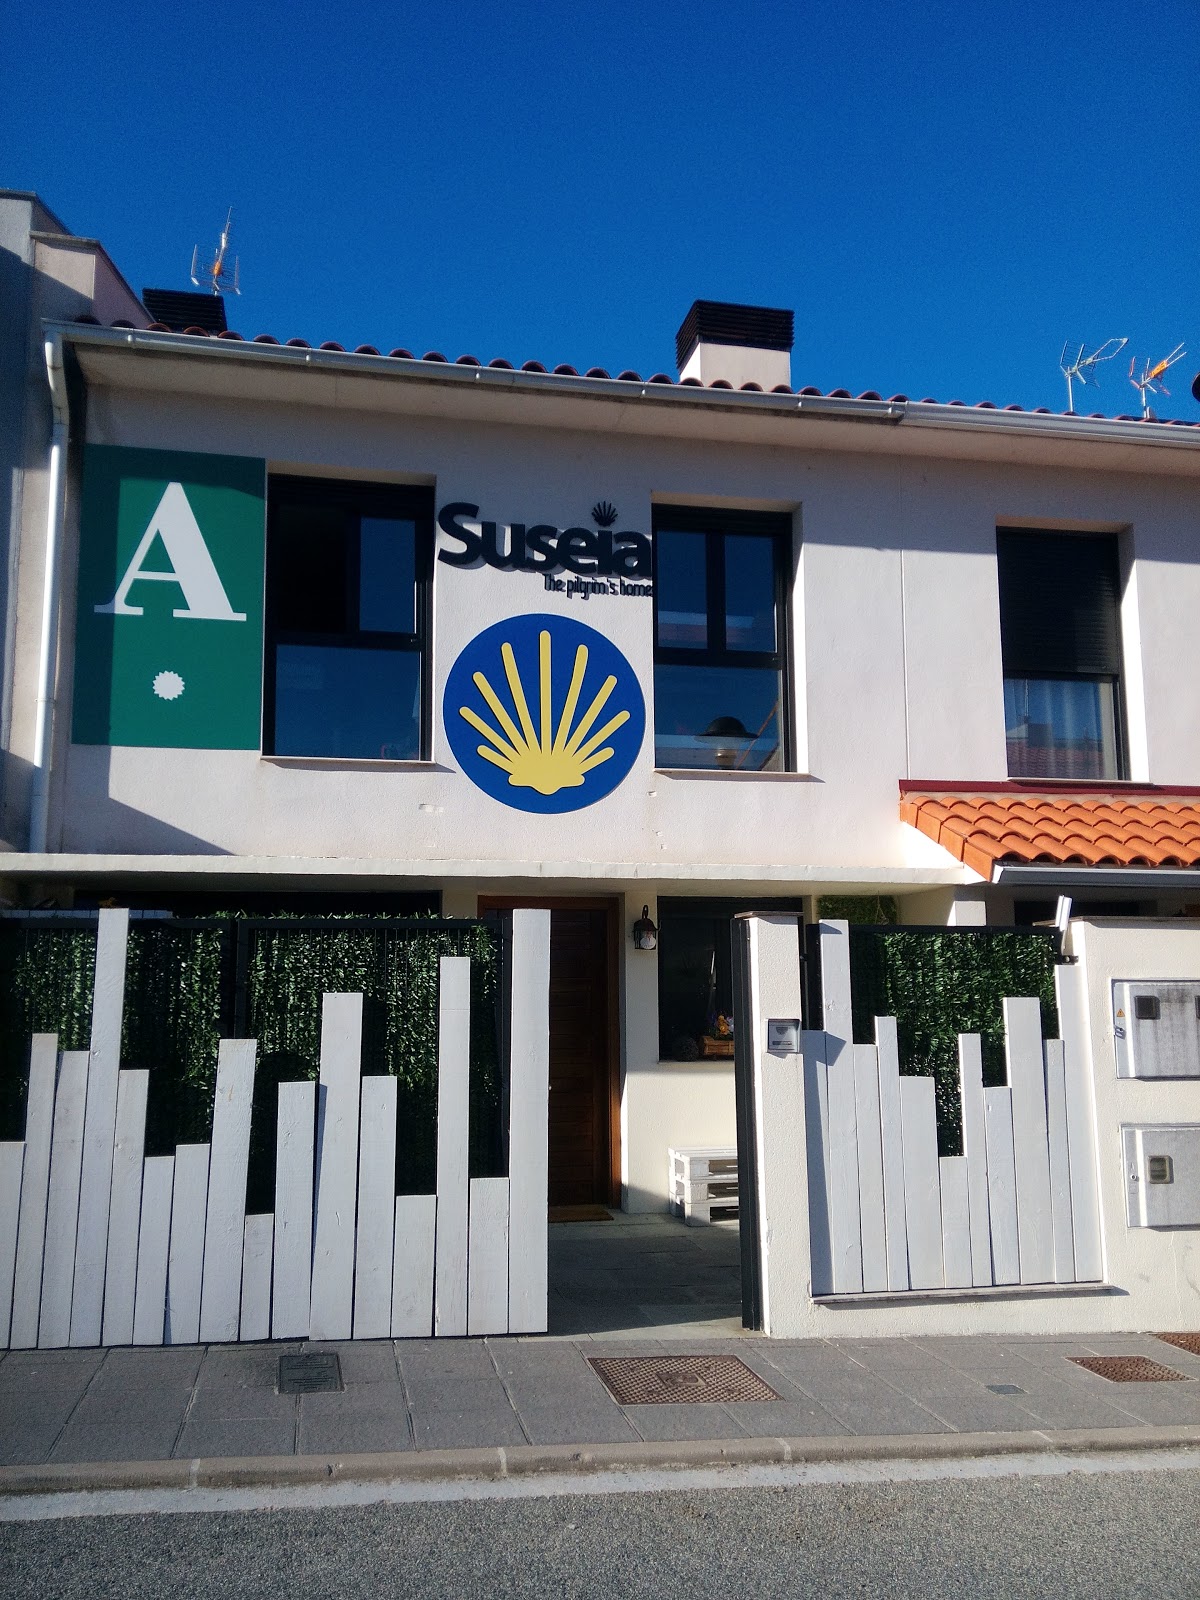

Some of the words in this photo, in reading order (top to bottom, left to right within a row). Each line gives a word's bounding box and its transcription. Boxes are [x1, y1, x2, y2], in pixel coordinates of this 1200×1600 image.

[93, 481, 247, 622] A
[437, 501, 653, 578] Suseia
[543, 573, 563, 592] The
[566, 575, 617, 600] pilgrim's
[619, 577, 654, 597] home
